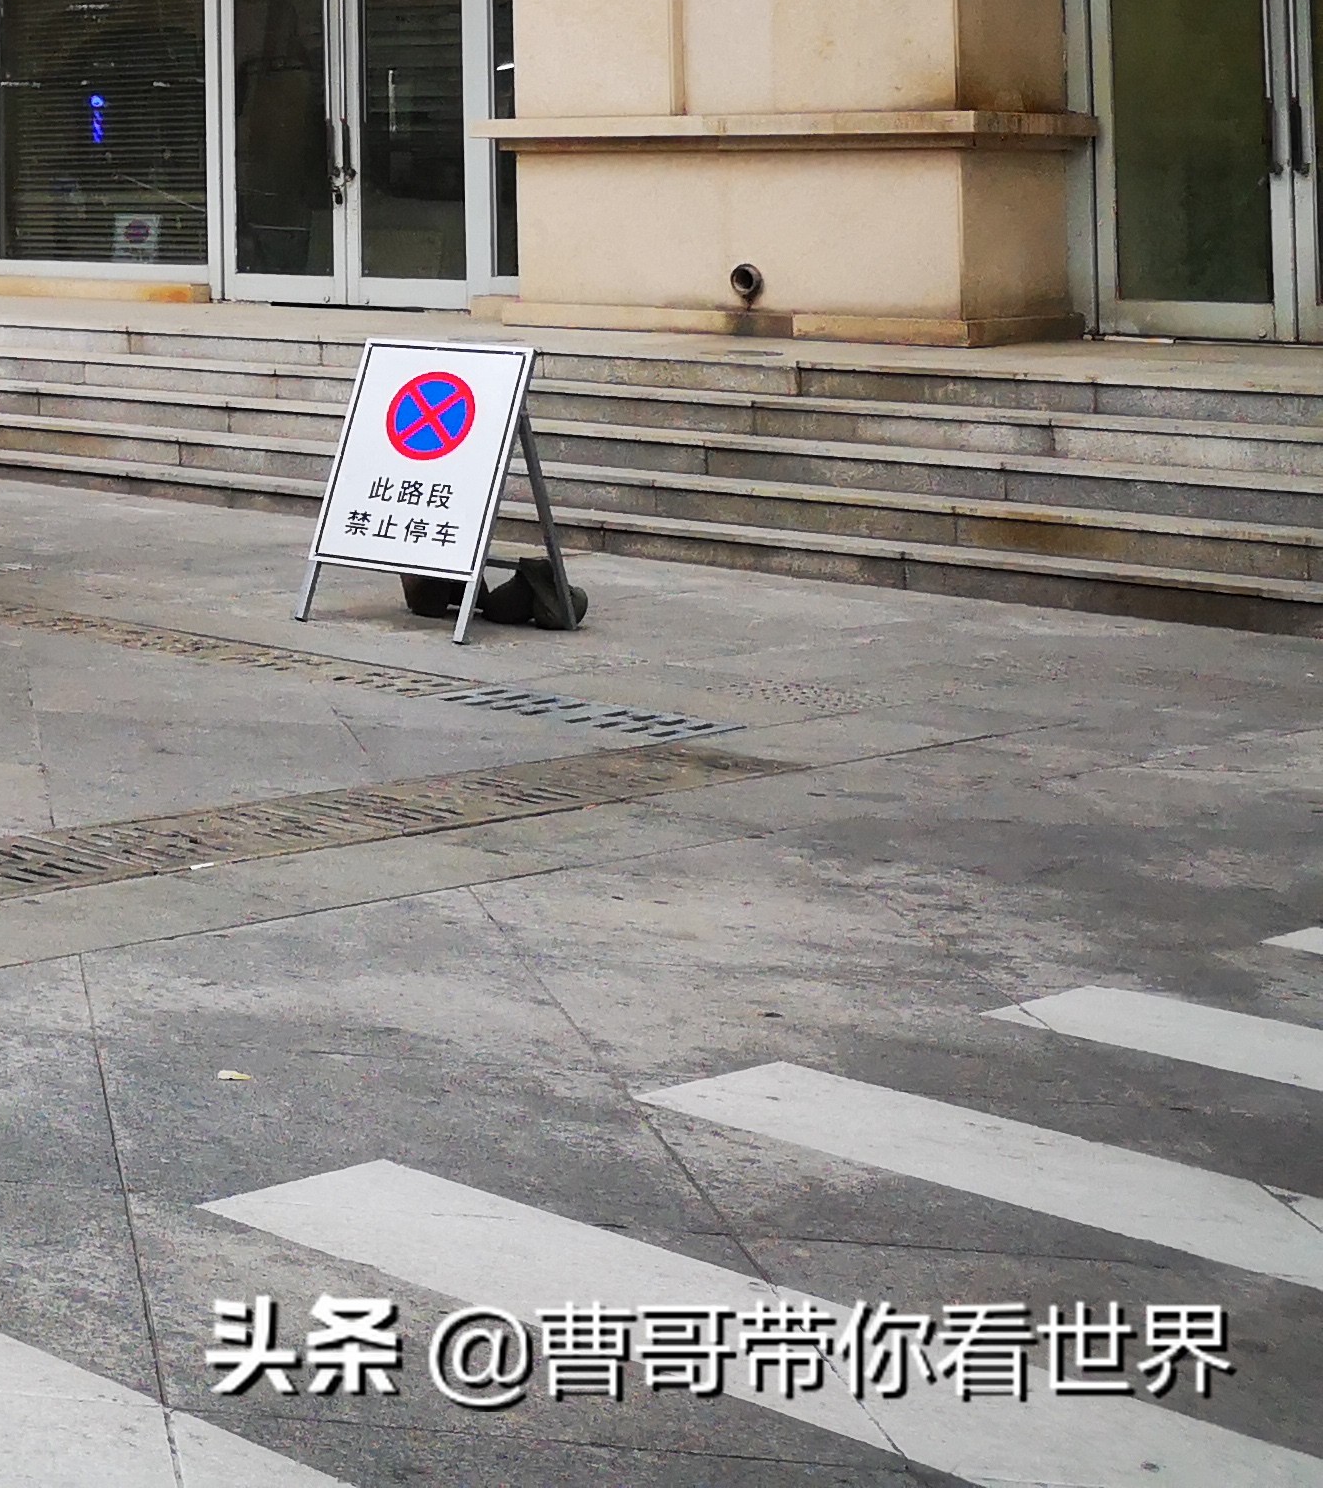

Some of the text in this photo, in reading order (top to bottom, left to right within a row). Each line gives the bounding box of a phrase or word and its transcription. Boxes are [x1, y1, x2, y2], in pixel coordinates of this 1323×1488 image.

[368, 476, 453, 510] 此路段
[344, 509, 460, 547] 禁止停车
